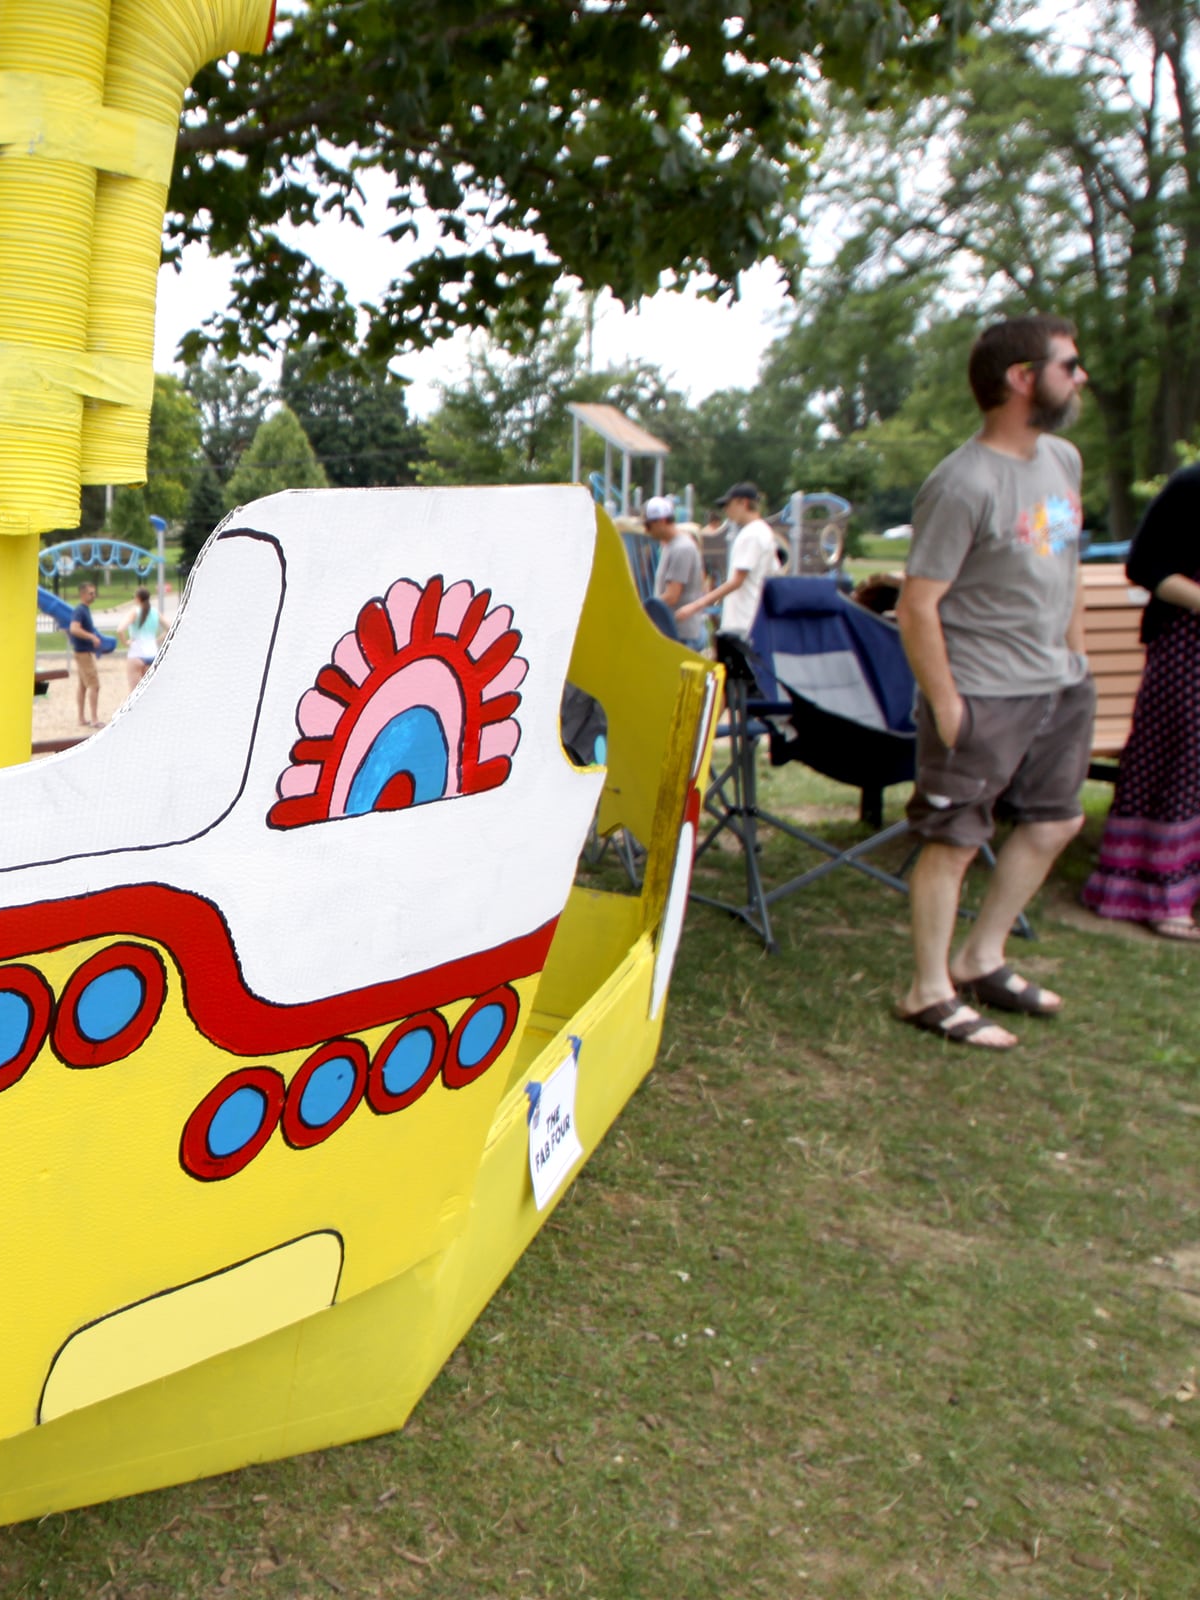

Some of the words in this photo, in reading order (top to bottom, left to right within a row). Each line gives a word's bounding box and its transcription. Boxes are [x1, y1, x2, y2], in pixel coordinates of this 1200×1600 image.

[546, 1104, 560, 1133] THE
[535, 1141, 550, 1173] FAB
[551, 1113, 570, 1152] FOUR
